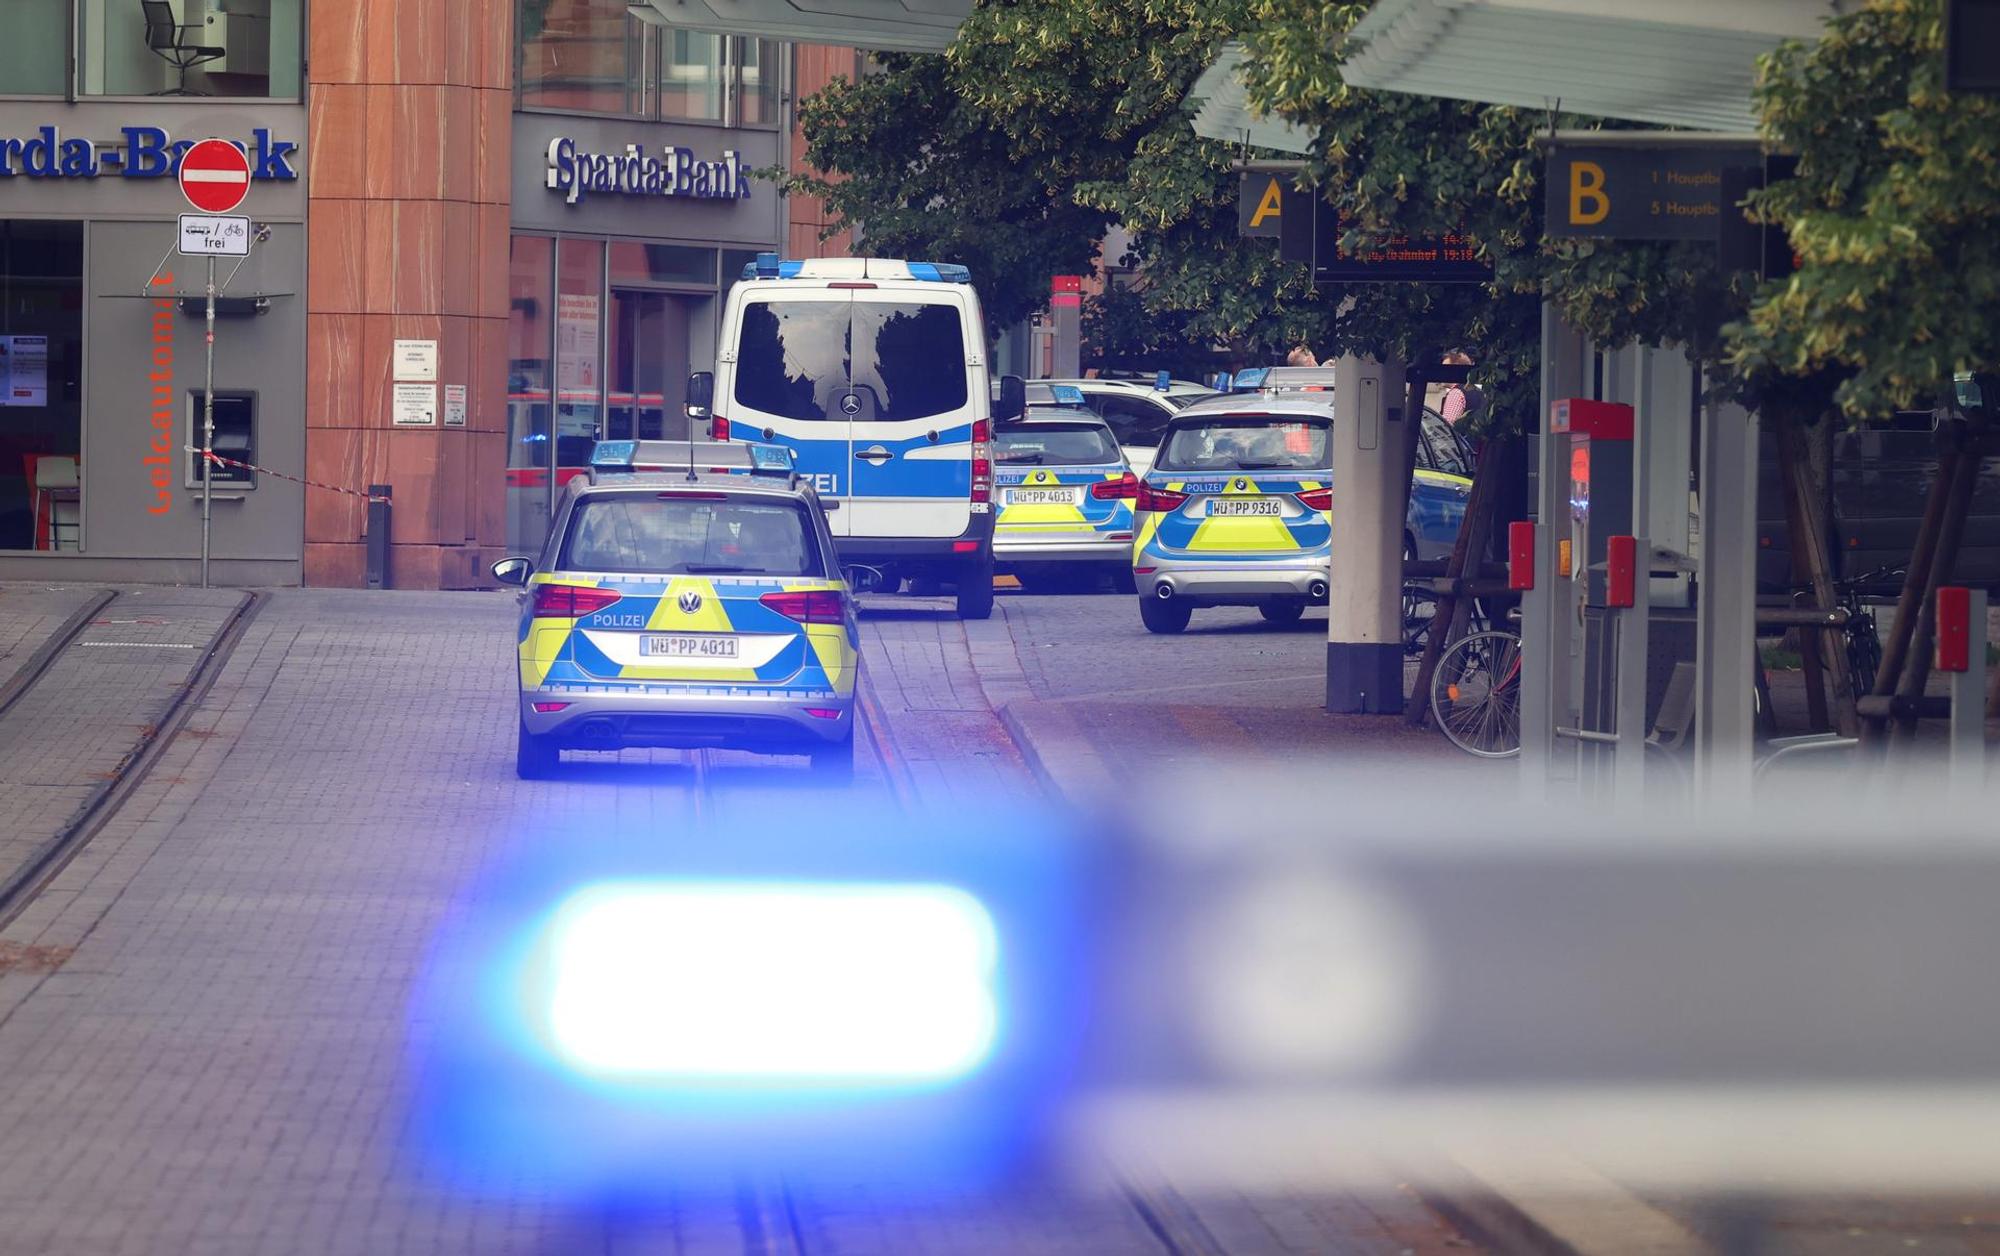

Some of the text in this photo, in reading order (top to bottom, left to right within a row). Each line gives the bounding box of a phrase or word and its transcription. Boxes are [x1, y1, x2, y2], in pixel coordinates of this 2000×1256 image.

[547, 137, 752, 203] Sparda-Bank
[1569, 161, 1610, 225] B
[1249, 177, 1281, 227] A
[1666, 201, 1719, 218] Hauptb
[205, 238, 225, 249] frei
[1186, 483, 1222, 492] POLIZEI
[1033, 491, 1046, 502] PP
[1048, 491, 1073, 502] 4013
[1235, 502, 1249, 514] PP
[1252, 502, 1279, 514] 9316
[593, 614, 645, 627] POLIZEI
[679, 639, 697, 654] PP
[700, 640, 735, 655] 4011
